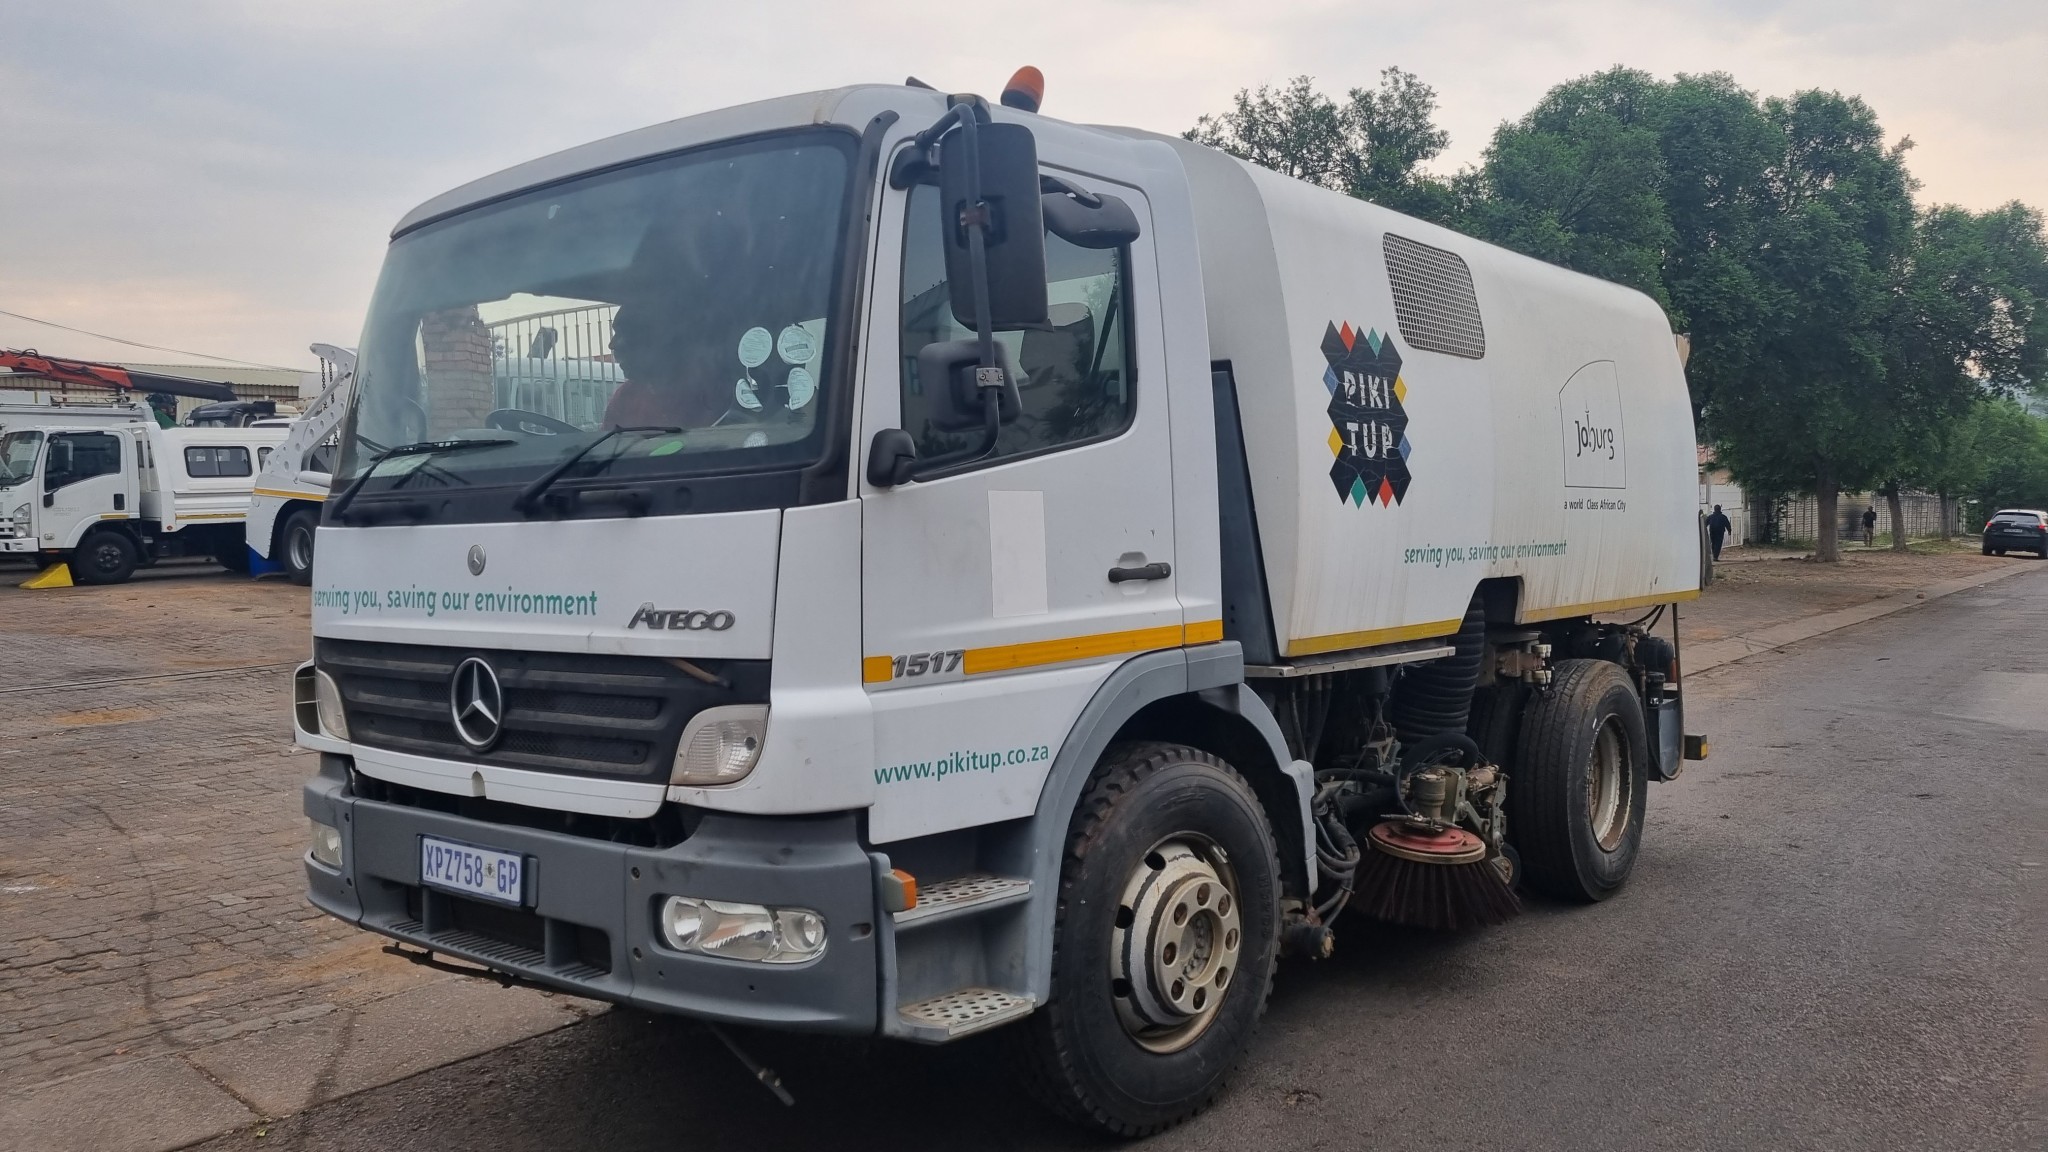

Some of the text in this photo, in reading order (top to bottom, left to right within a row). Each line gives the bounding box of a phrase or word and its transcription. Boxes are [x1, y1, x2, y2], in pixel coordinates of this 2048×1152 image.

[1343, 370, 1390, 410] PIKI
[1346, 420, 1393, 459] TUP
[1569, 499, 1584, 510] world
[1586, 500, 1599, 510] Class
[1600, 499, 1616, 511] African
[1617, 500, 1626, 512] City
[1404, 539, 1568, 568] serving you, saving our environment
[314, 584, 598, 617] serving you, saving our environment
[892, 649, 966, 678] 1517
[874, 744, 1049, 785] www.pikitup.co.za
[425, 844, 518, 895] XPZ758 GP
